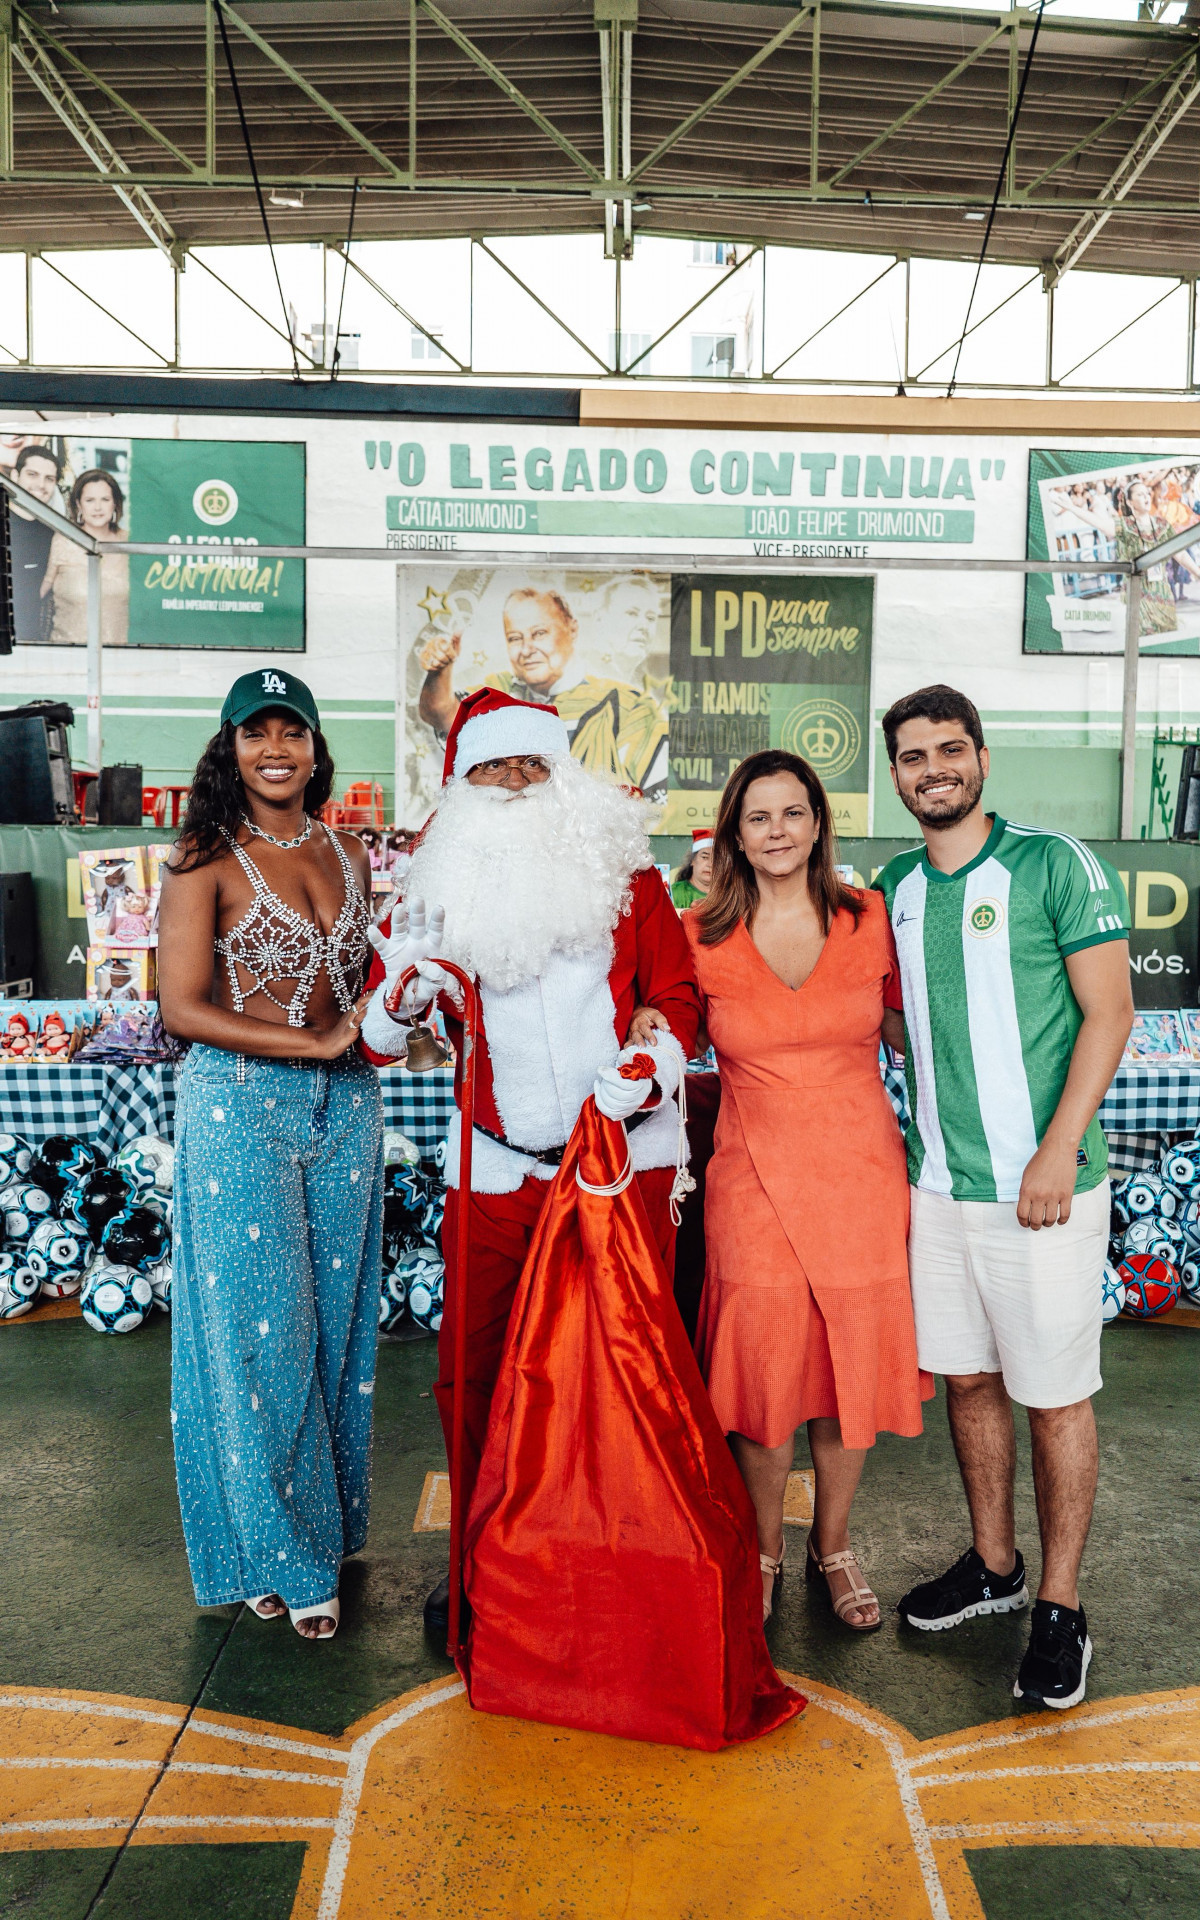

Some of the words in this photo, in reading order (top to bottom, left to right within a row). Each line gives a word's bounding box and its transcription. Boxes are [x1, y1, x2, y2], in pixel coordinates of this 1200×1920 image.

[450, 444, 667, 493] LEGADO
[690, 449, 1006, 501] CONTINUA"
[399, 497, 442, 527] CÁTIA
[445, 503, 527, 530] DRUMOND
[748, 507, 790, 535] JOÃO
[797, 511, 848, 536] FELIPE
[857, 513, 945, 538] DRUMOND
[168, 535, 182, 569] O
[386, 534, 458, 551] PRESIDENTE
[753, 543, 870, 559] VICE-PRESIDENTE
[144, 561, 284, 597] CONTINUA!
[691, 590, 767, 658] LPD
[766, 600, 830, 630] para
[767, 626, 860, 658] sempre
[261, 671, 287, 695] LA
[702, 681, 771, 716] RAMOS
